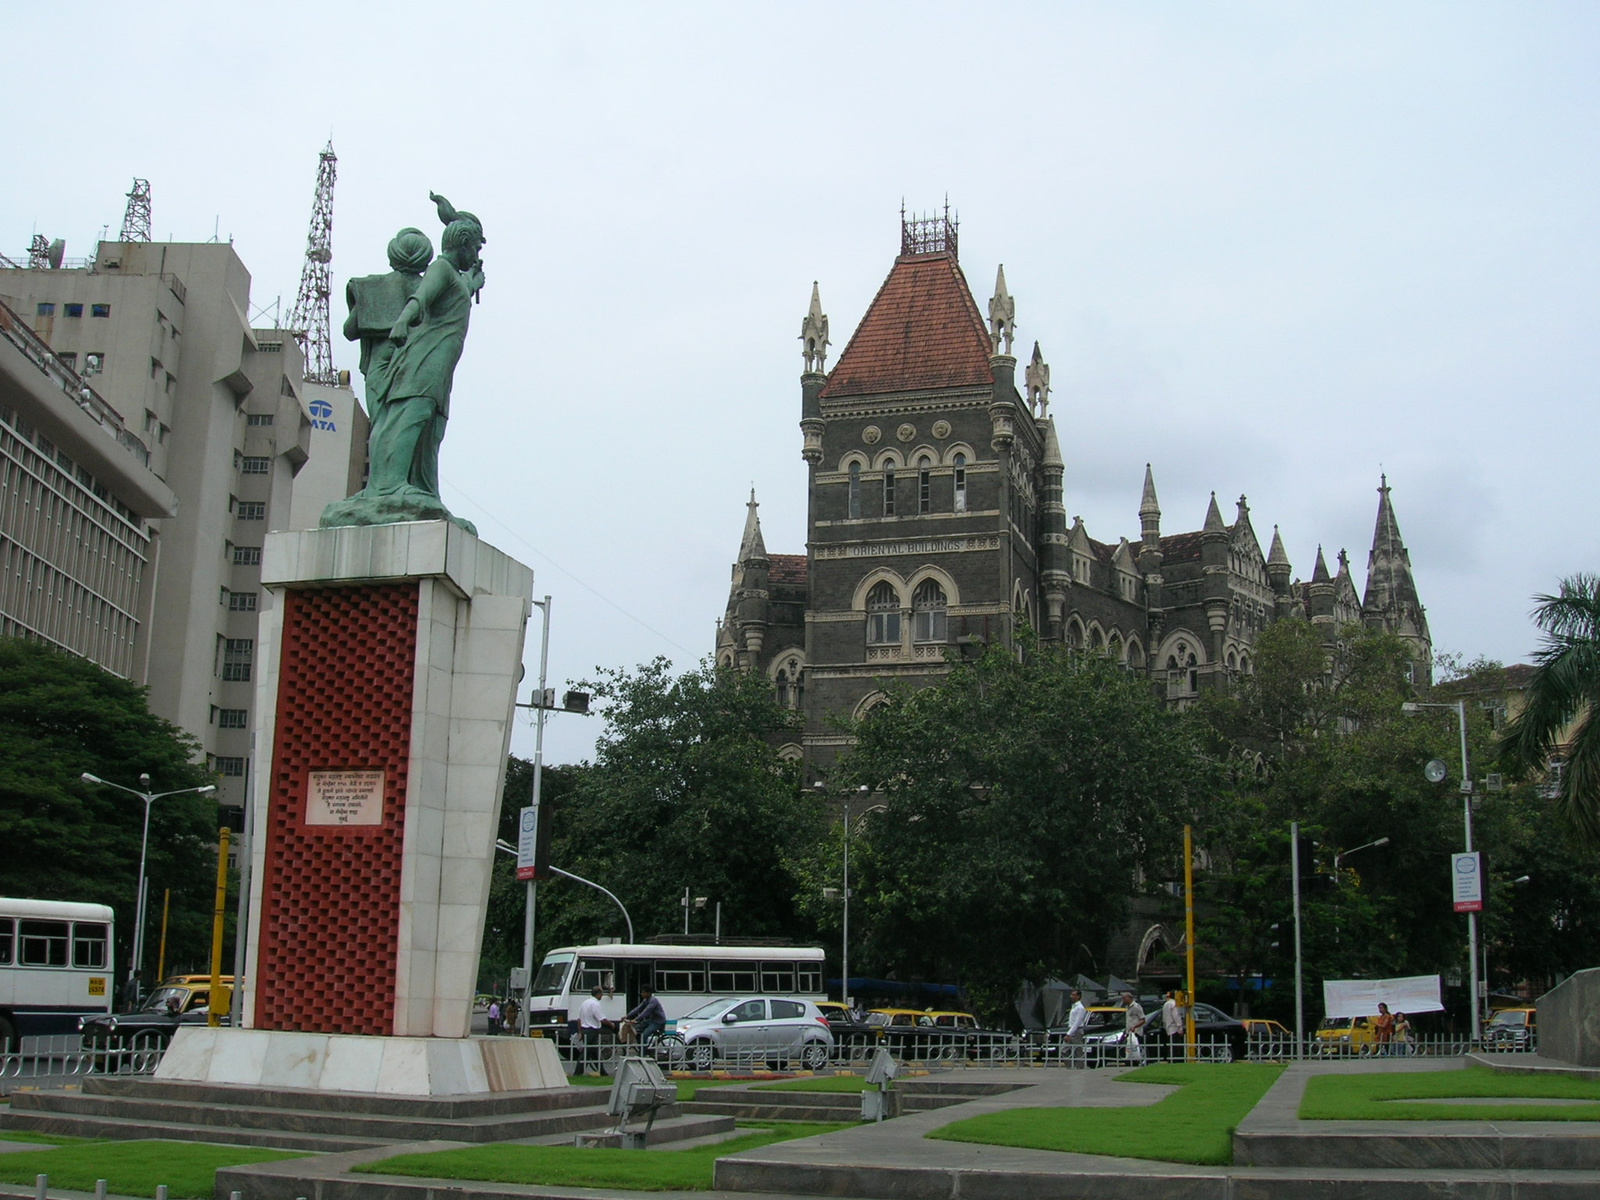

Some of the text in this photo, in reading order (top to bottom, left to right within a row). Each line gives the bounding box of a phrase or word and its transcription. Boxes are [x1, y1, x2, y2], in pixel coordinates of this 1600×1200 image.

[312, 418, 336, 432] ATA
[853, 541, 960, 556] ORIENTAL BUILDINGS
